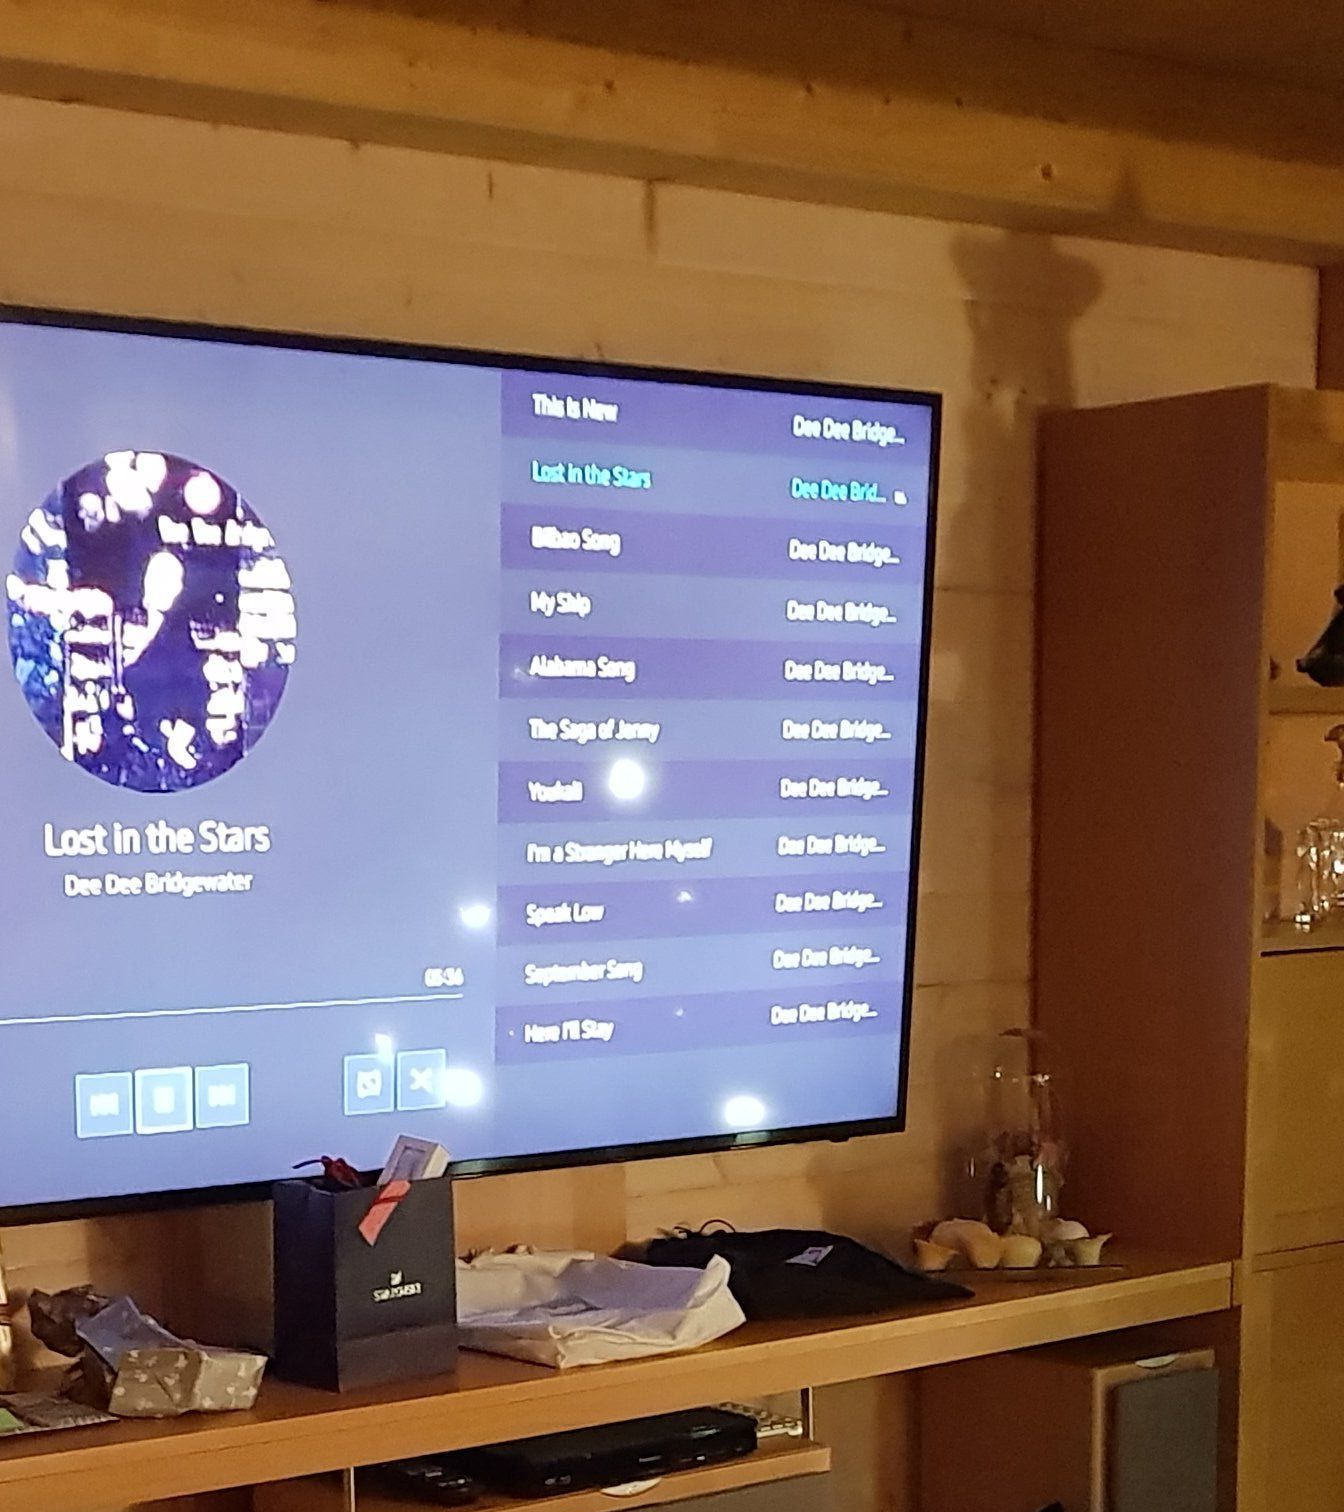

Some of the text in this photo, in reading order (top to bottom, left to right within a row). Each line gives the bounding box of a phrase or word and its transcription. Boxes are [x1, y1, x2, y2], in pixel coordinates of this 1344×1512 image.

[532, 393, 565, 418] This
[582, 397, 618, 422] New
[793, 414, 822, 438] Dee
[822, 417, 851, 440] Dee
[532, 460, 566, 483] Lost
[584, 463, 611, 487] the
[612, 465, 651, 489] Stars
[791, 477, 819, 499] Dee
[820, 479, 848, 501] Dee
[581, 528, 621, 557] Song
[789, 538, 818, 561] Dee
[818, 540, 846, 562] Dee
[530, 590, 591, 618] My Ship
[787, 599, 815, 621] Dee
[816, 600, 843, 622] Dee
[528, 655, 636, 683] Alabama Song
[784, 660, 813, 681] Dee
[814, 660, 841, 681] Dee
[528, 718, 558, 740] The
[559, 718, 597, 745] Saga
[598, 718, 615, 740] of
[782, 719, 810, 739] Dee
[811, 719, 839, 739] Dee
[780, 778, 808, 798] Dee
[808, 778, 836, 797] Dee
[44, 819, 271, 857] Lost in the Stars
[778, 836, 805, 856] Dee
[806, 835, 833, 855] Dee
[527, 843, 551, 863] I'm
[552, 846, 564, 863] a
[64, 870, 253, 897] Dee Dee Bridgewater
[526, 902, 605, 928] Speak Low
[775, 893, 803, 913] Dee
[804, 892, 831, 911] Dee
[773, 949, 801, 969] Dee
[801, 948, 828, 967] Dee
[524, 959, 643, 987] September Song
[771, 1005, 798, 1025] Dee
[799, 1004, 826, 1023] Dee
